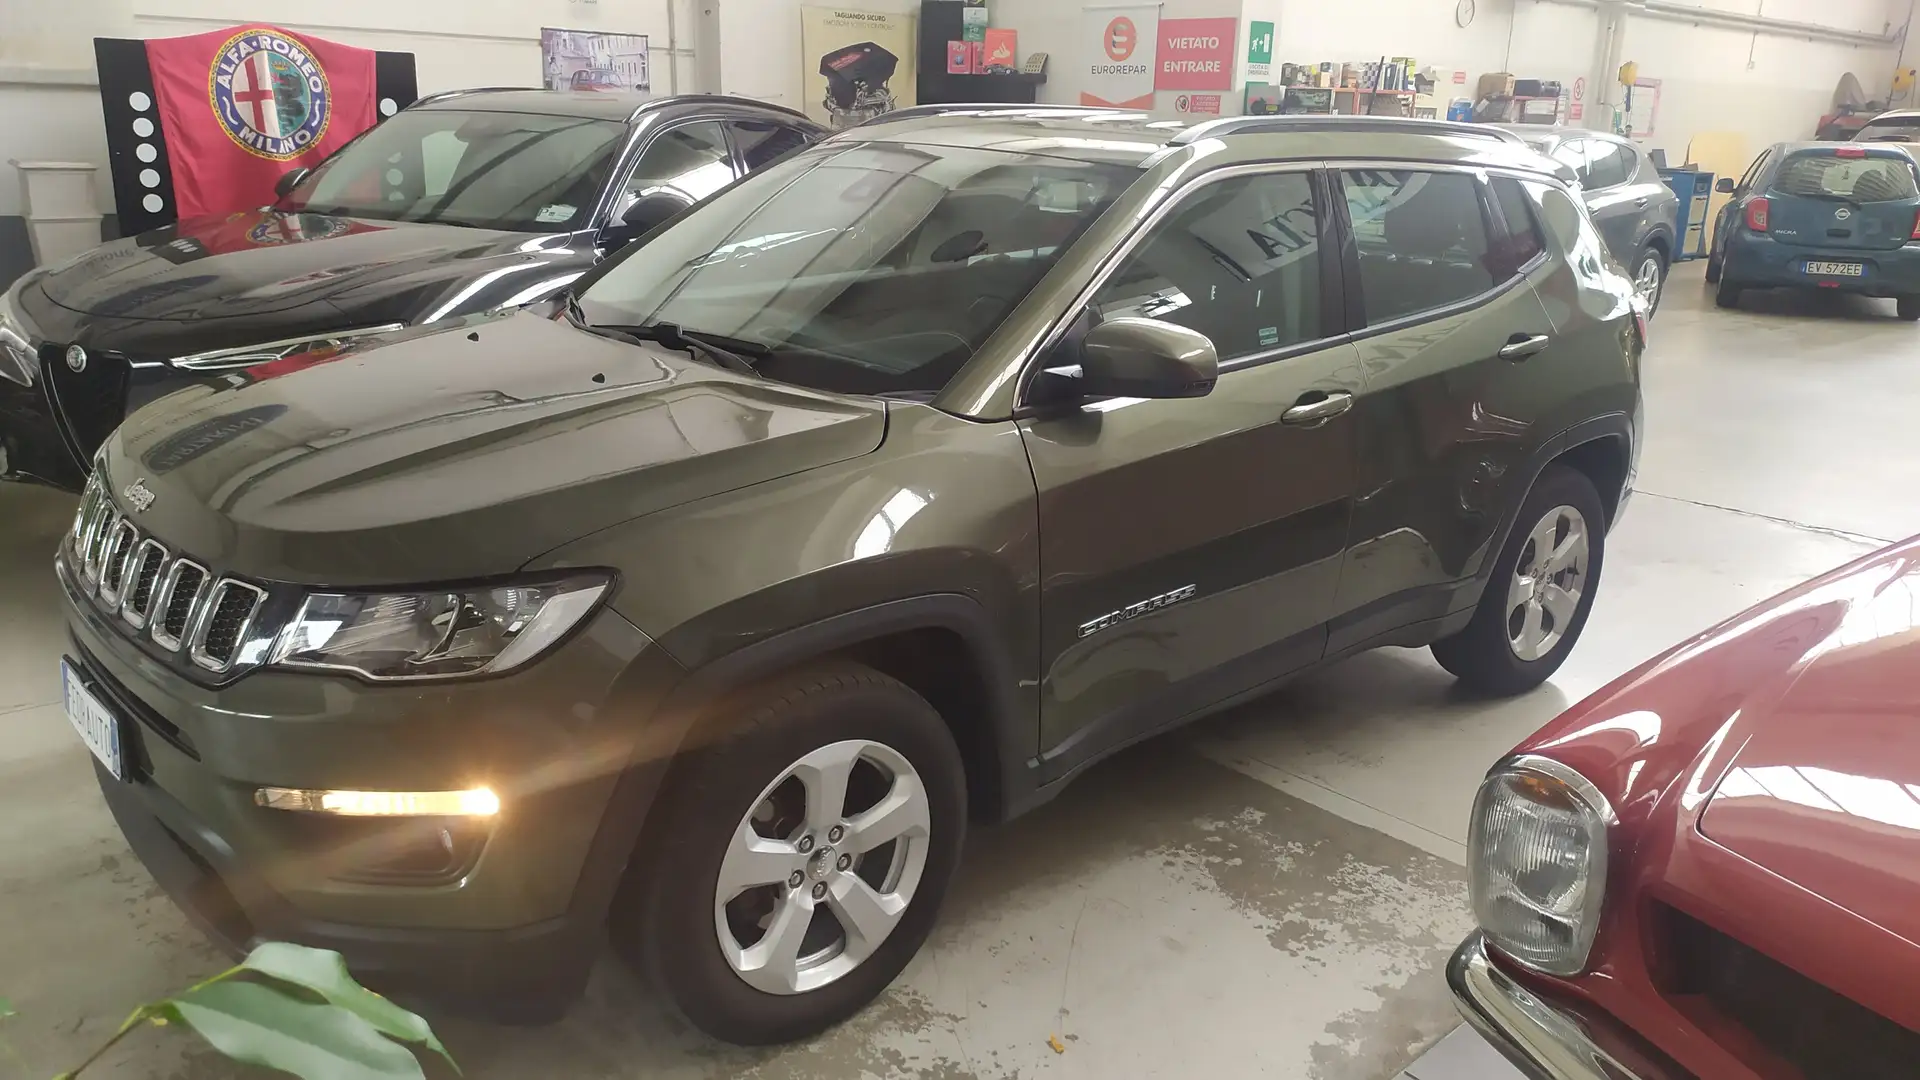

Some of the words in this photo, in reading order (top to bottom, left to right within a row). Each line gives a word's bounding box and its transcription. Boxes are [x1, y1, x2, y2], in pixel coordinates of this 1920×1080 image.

[834, 11, 866, 21] TAGLIANDO
[866, 14, 887, 22] SICURO
[1168, 36, 1220, 50] VIETATO
[1091, 64, 1147, 75] EUROREPAR
[1163, 60, 1222, 73] ENTRARE
[1807, 262, 1822, 273] EV
[1825, 263, 1861, 275] 572EE
[1078, 583, 1197, 638] COMPASS
